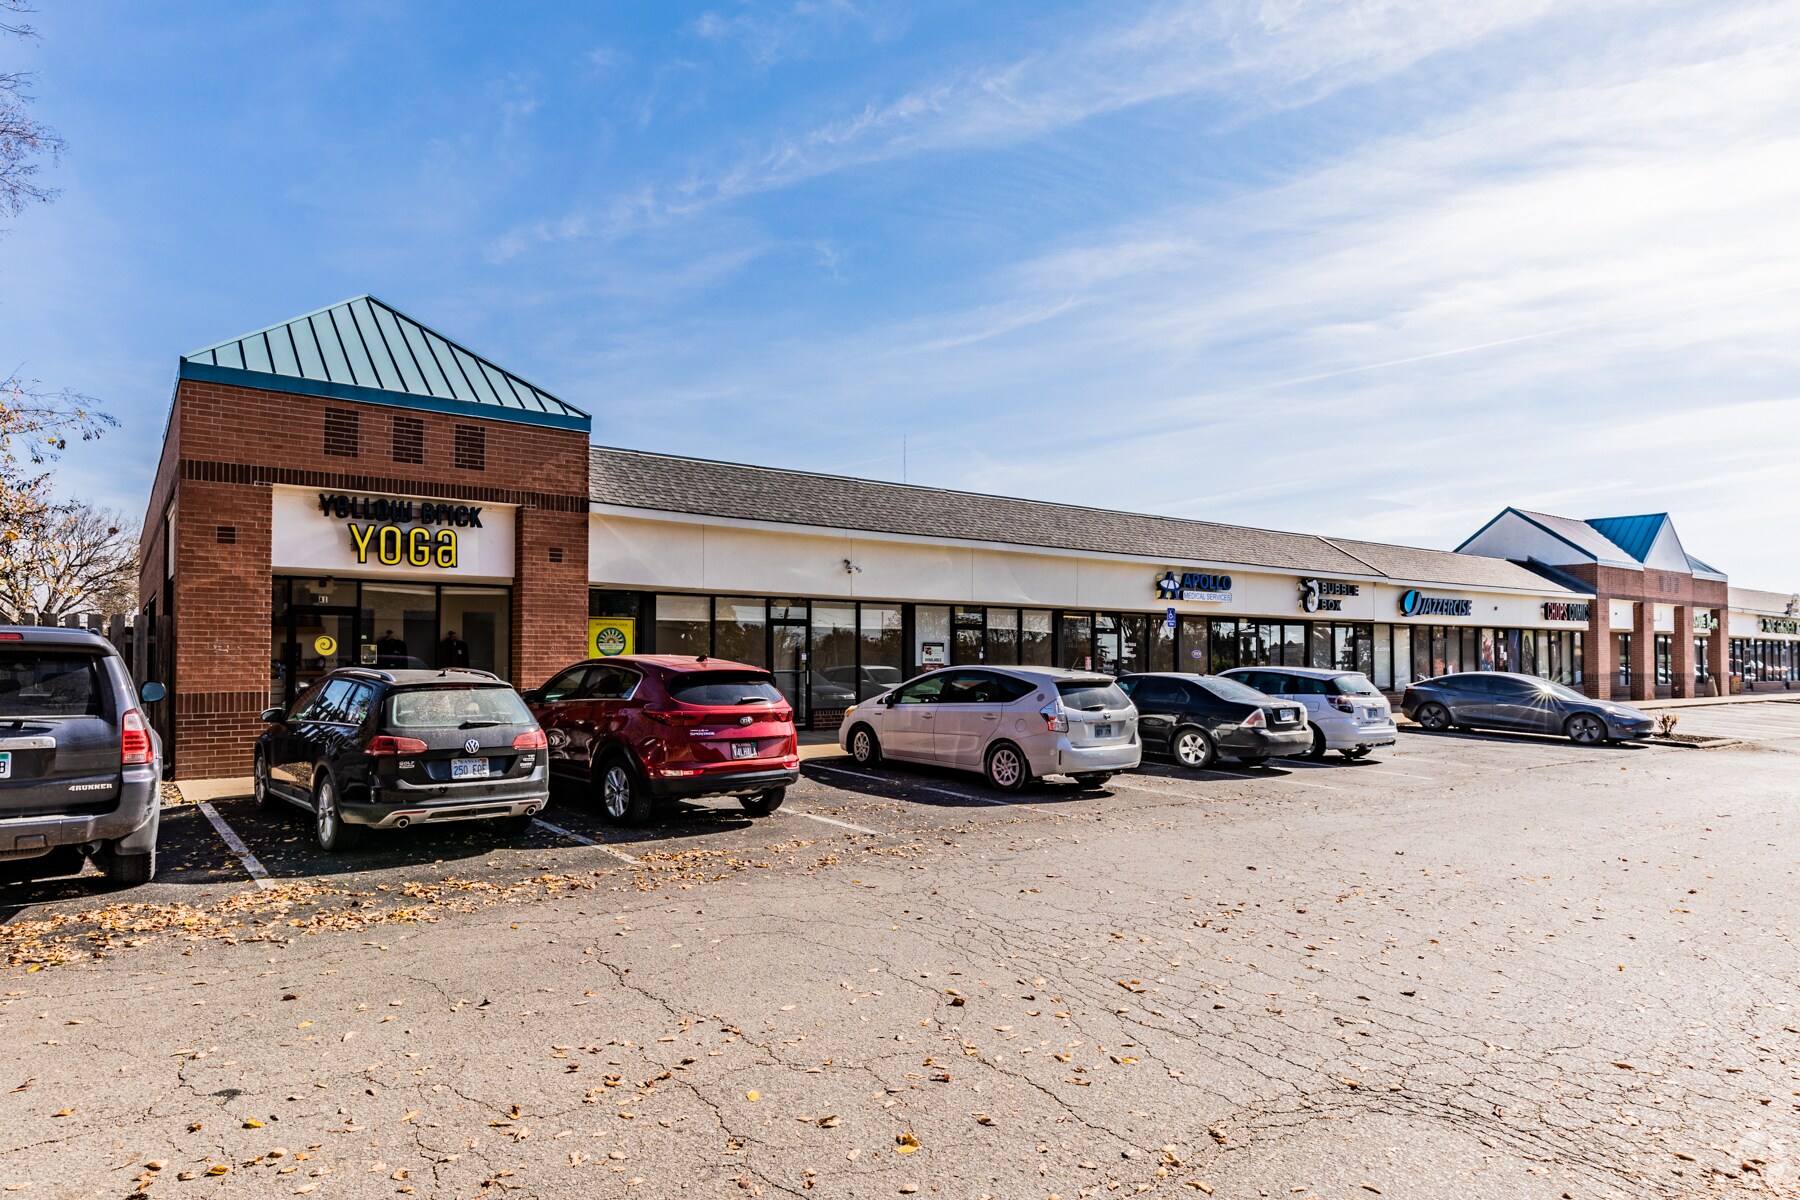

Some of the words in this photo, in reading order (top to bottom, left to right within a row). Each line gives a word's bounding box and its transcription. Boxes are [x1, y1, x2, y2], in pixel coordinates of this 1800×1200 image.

[348, 523, 458, 568] YOGa
[1181, 572, 1232, 590] APOLLO
[1320, 582, 1360, 596] BUBBLE
[1184, 591, 1206, 600] MEDICAL
[1206, 593, 1232, 602] SERVICES
[1320, 599, 1342, 611] BOX
[1420, 597, 1472, 616] JAZZERCISE
[1547, 602, 1568, 620] CHOPS
[453, 765, 468, 776] 250
[68, 783, 113, 792] 4RUNNER
